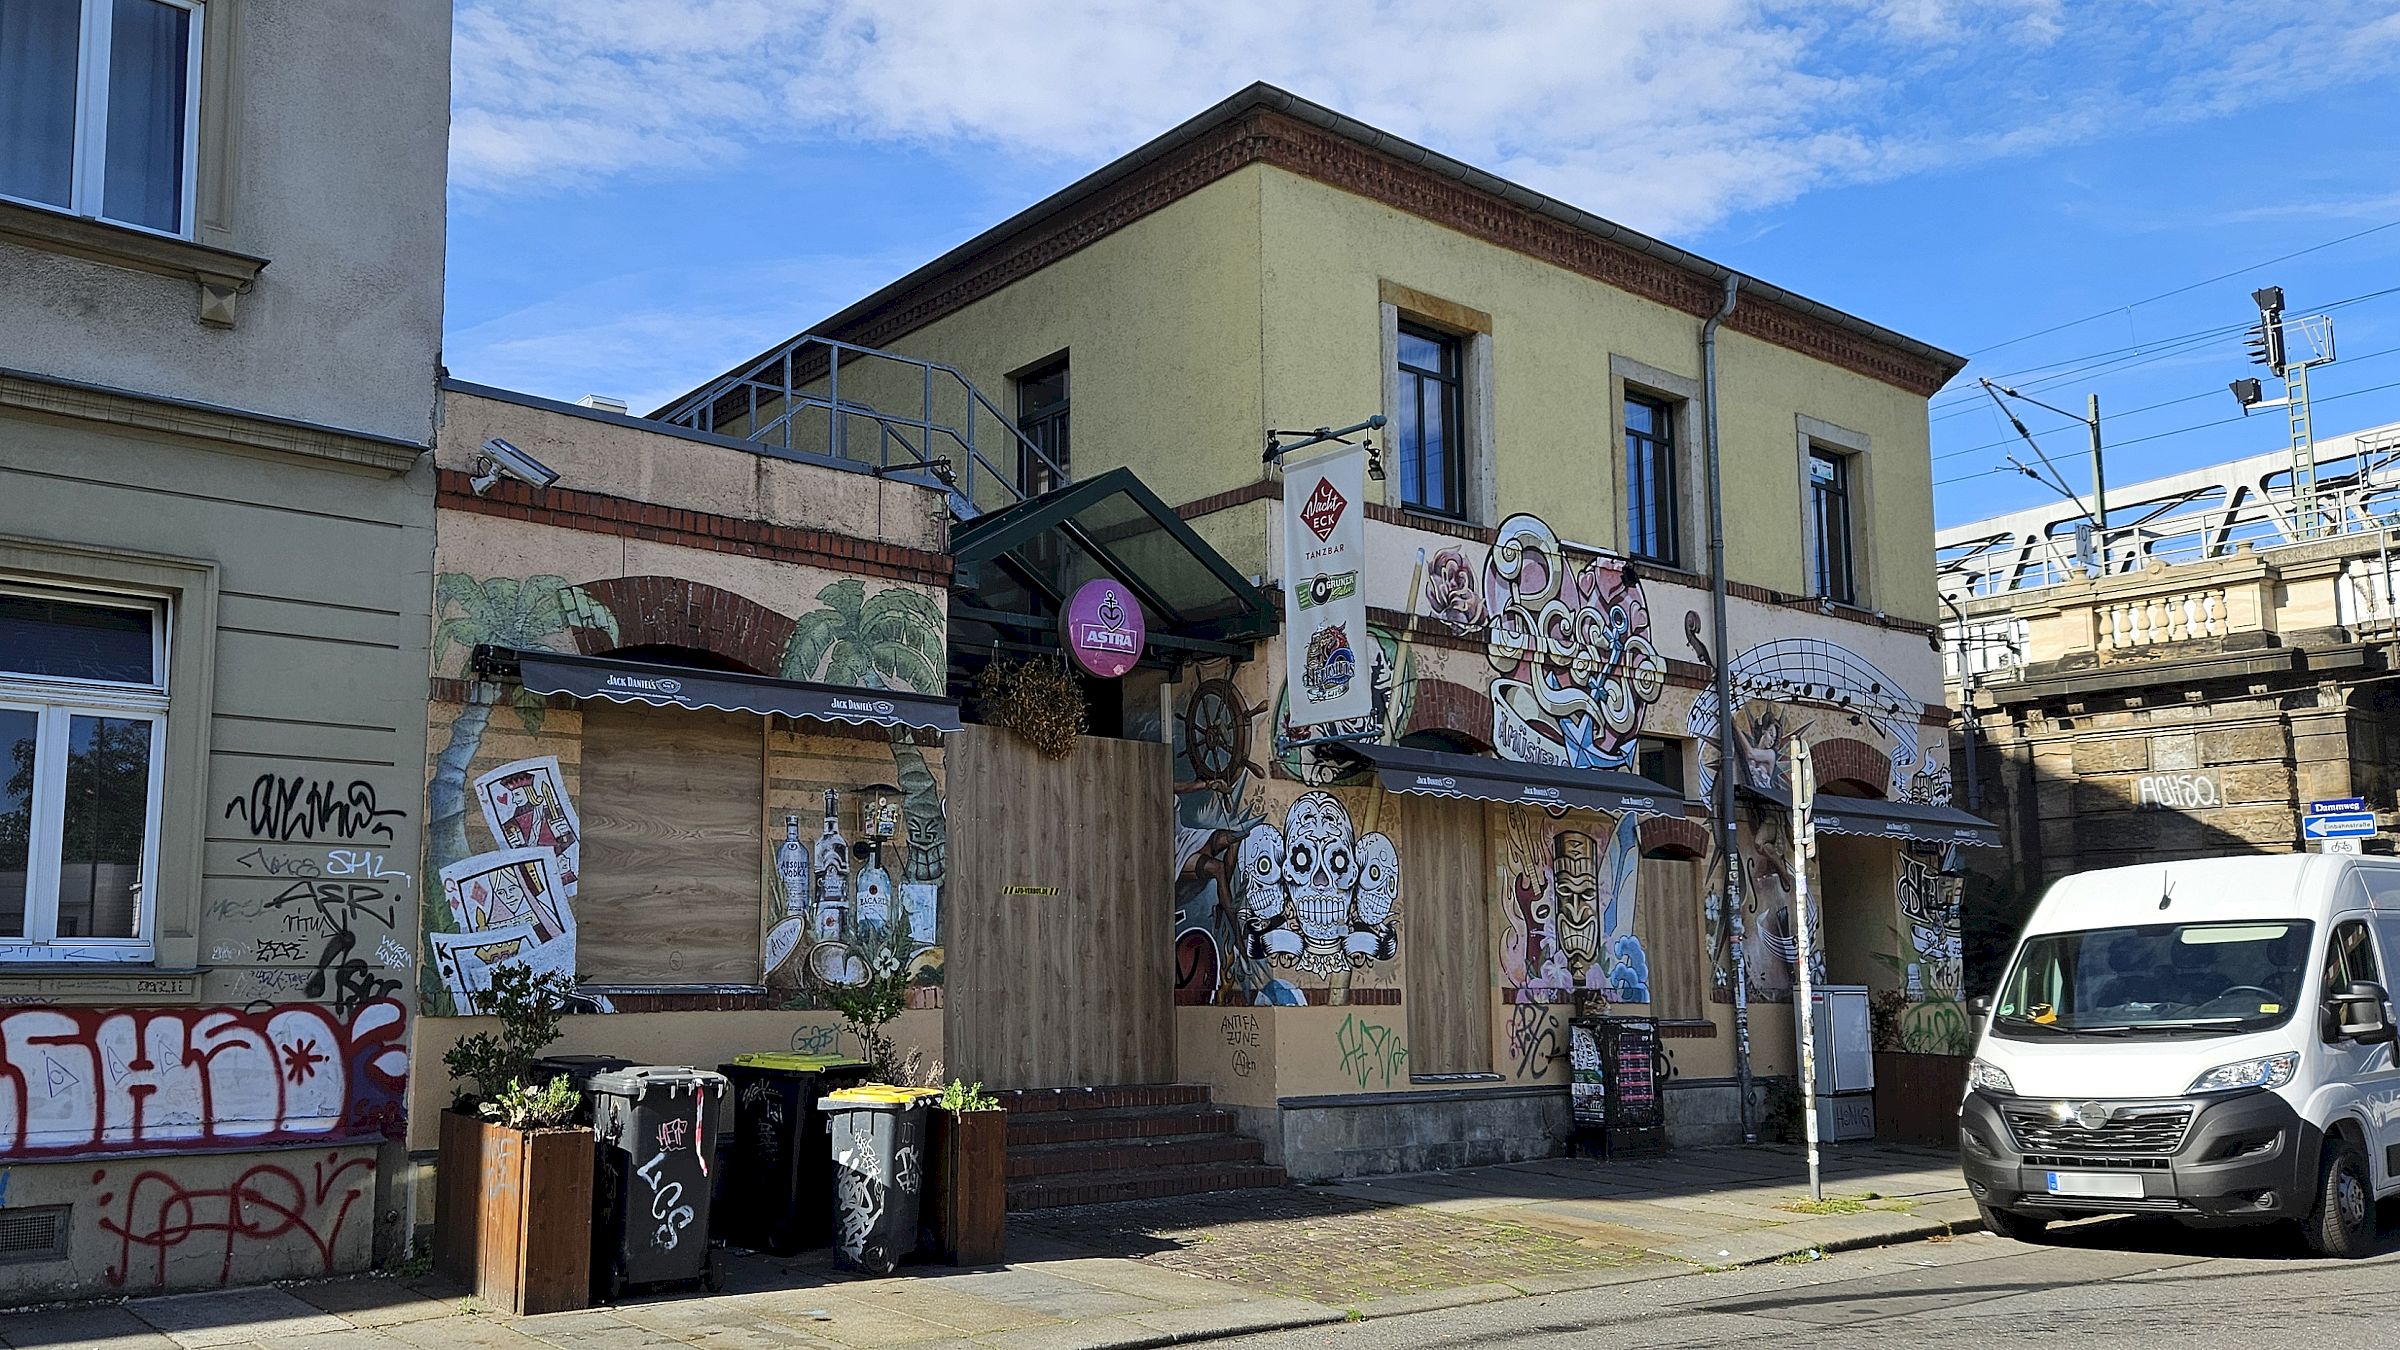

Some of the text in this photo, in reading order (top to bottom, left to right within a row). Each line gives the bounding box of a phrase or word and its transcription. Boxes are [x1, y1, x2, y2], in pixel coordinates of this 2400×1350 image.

[1303, 486, 1343, 520] Nacht
[1313, 513, 1335, 528] ECK
[1305, 543, 1345, 560] TANZBAR
[1086, 630, 1132, 647] ASTRA
[477, 783, 485, 796] J
[2314, 802, 2360, 813] Dammweg
[2323, 821, 2371, 831] Einbahnstraße
[781, 860, 808, 870] ABSOLUT
[783, 869, 806, 879] VODKA
[444, 877, 459, 893] Q
[435, 941, 453, 963] K
[1220, 1014, 1260, 1033] ANTIFA
[1226, 1031, 1260, 1048] ZONE
